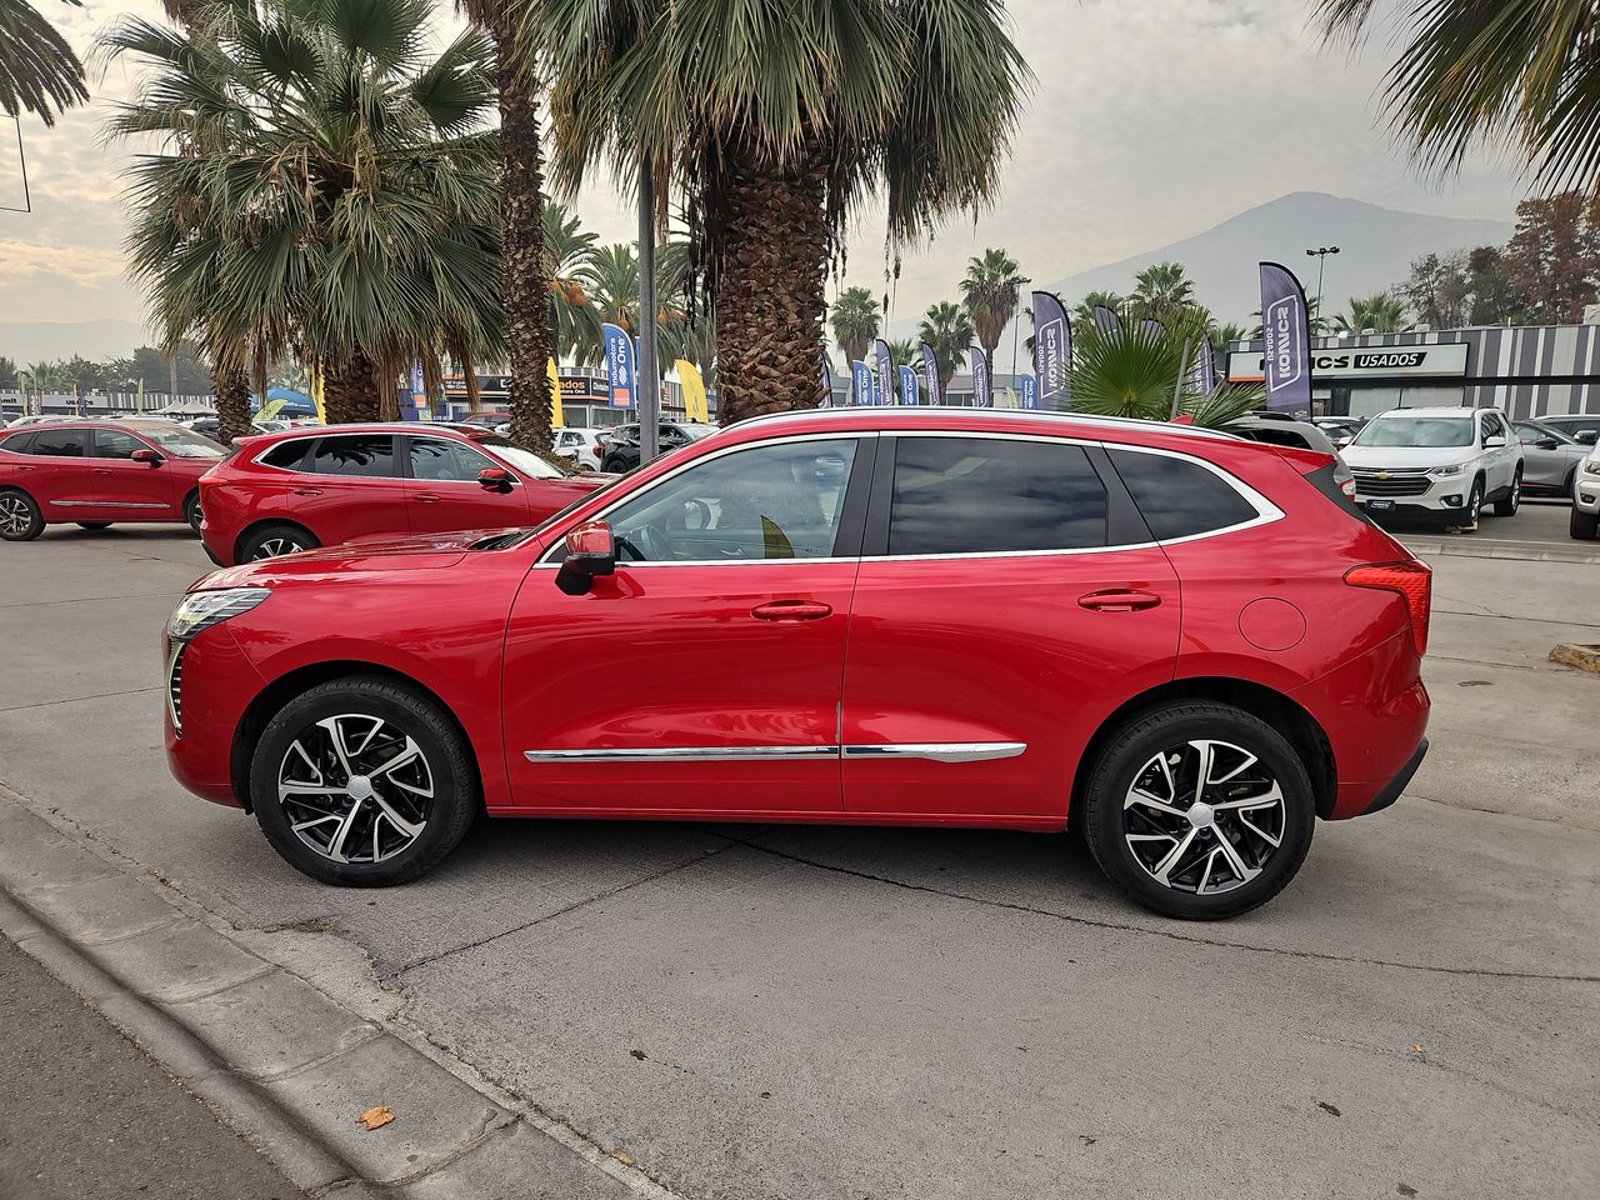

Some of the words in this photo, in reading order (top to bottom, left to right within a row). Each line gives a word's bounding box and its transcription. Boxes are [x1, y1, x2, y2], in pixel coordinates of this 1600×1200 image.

[617, 337, 626, 364] One
[1359, 353, 1419, 368] USADOS
[610, 337, 618, 386] Indumotora
[559, 380, 585, 389] ados
